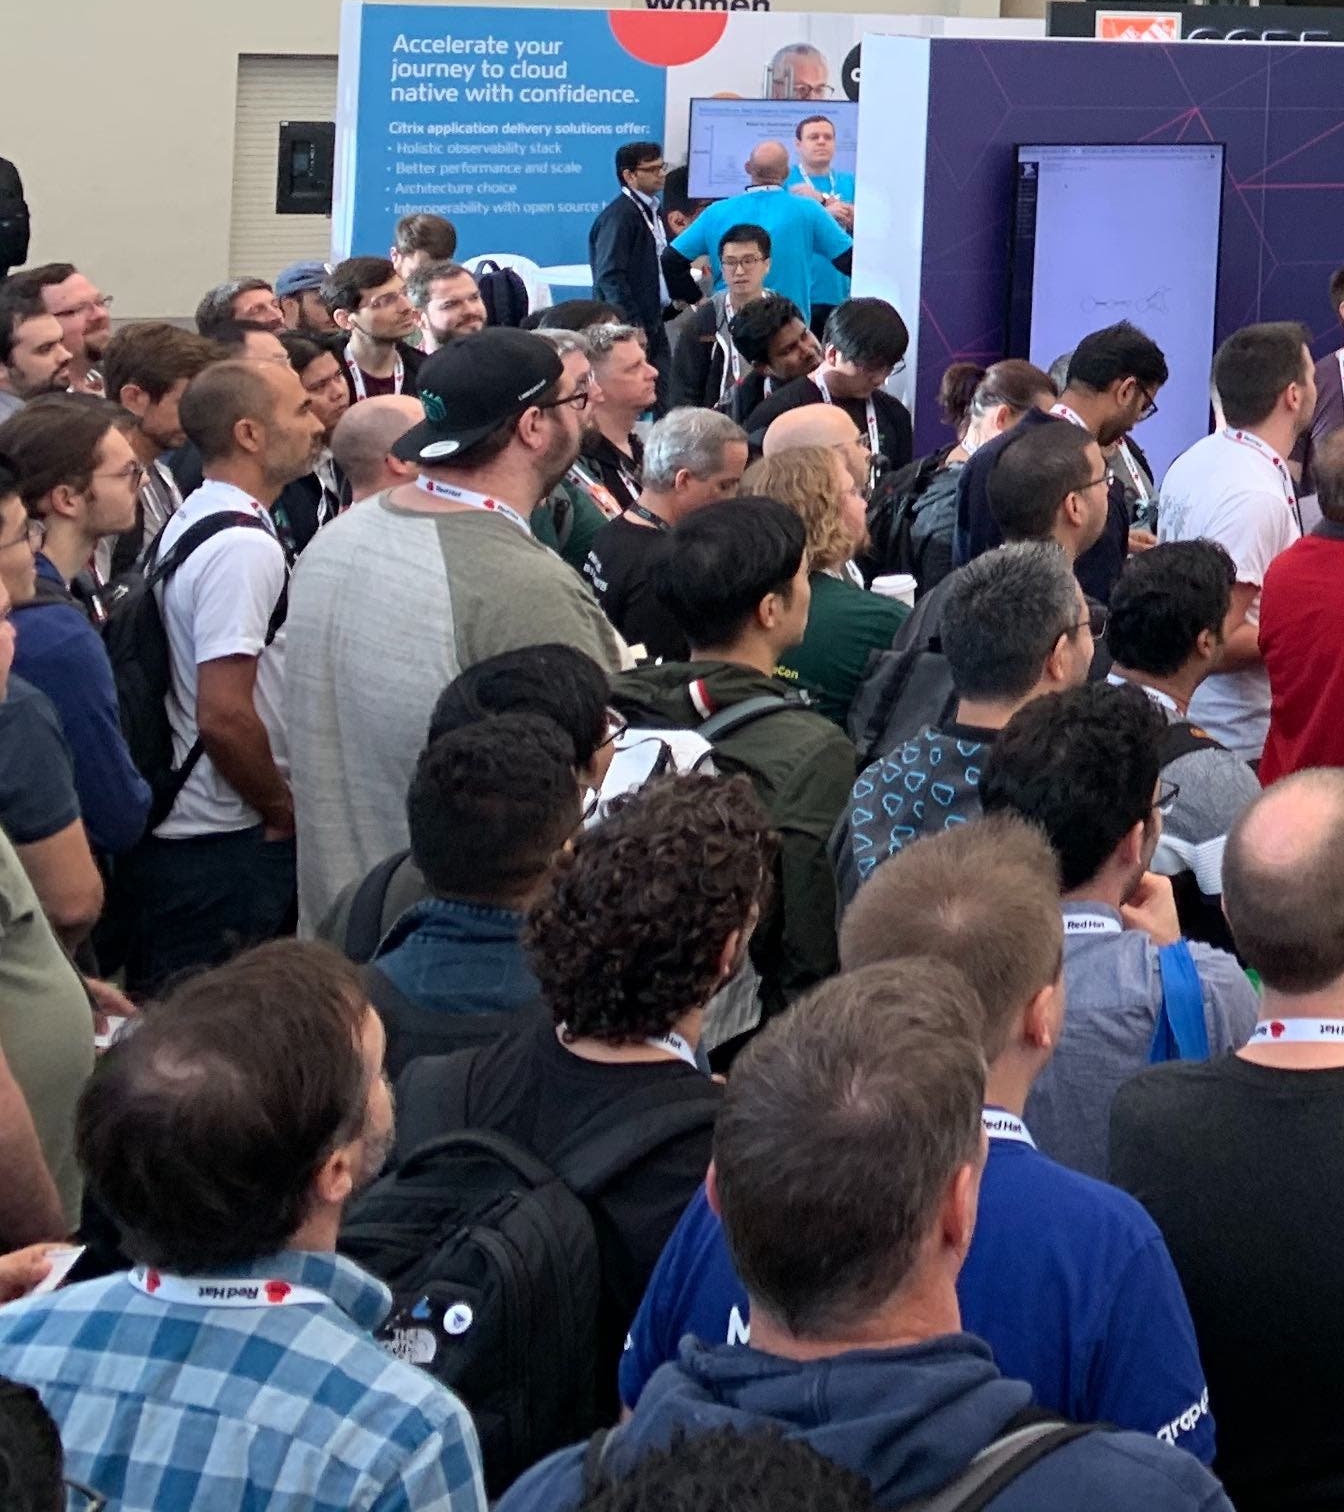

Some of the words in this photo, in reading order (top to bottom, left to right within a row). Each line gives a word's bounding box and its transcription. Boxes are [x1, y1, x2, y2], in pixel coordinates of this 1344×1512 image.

[393, 34, 509, 55] Accelerate
[515, 39, 563, 59] your
[390, 58, 475, 81] journey
[481, 60, 504, 78] to
[510, 61, 568, 79] cloud
[391, 83, 458, 102] native
[465, 83, 513, 102] with
[520, 85, 640, 104] confidence.
[389, 121, 424, 134] Citrix
[427, 122, 498, 137] application
[502, 122, 552, 136] delivery
[555, 123, 612, 135] solutions
[615, 123, 650, 135] offer:
[396, 143, 443, 154] Holistic
[447, 143, 525, 156] observability
[529, 143, 562, 154] stack
[396, 162, 436, 174] Better
[440, 163, 521, 176] performance
[525, 163, 547, 173] and
[551, 163, 582, 173] scale
[395, 182, 474, 194] Architecture
[477, 183, 517, 193] choice
[394, 202, 489, 216] Interoperability
[493, 202, 519, 213] with
[523, 203, 554, 215] open
[557, 203, 598, 213] source
[1067, 920, 1087, 929] Red
[1088, 921, 1105, 929] Hat
[1320, 1024, 1339, 1036] Hat
[199, 1286, 225, 1298] Hat
[226, 1287, 259, 1299] Red
